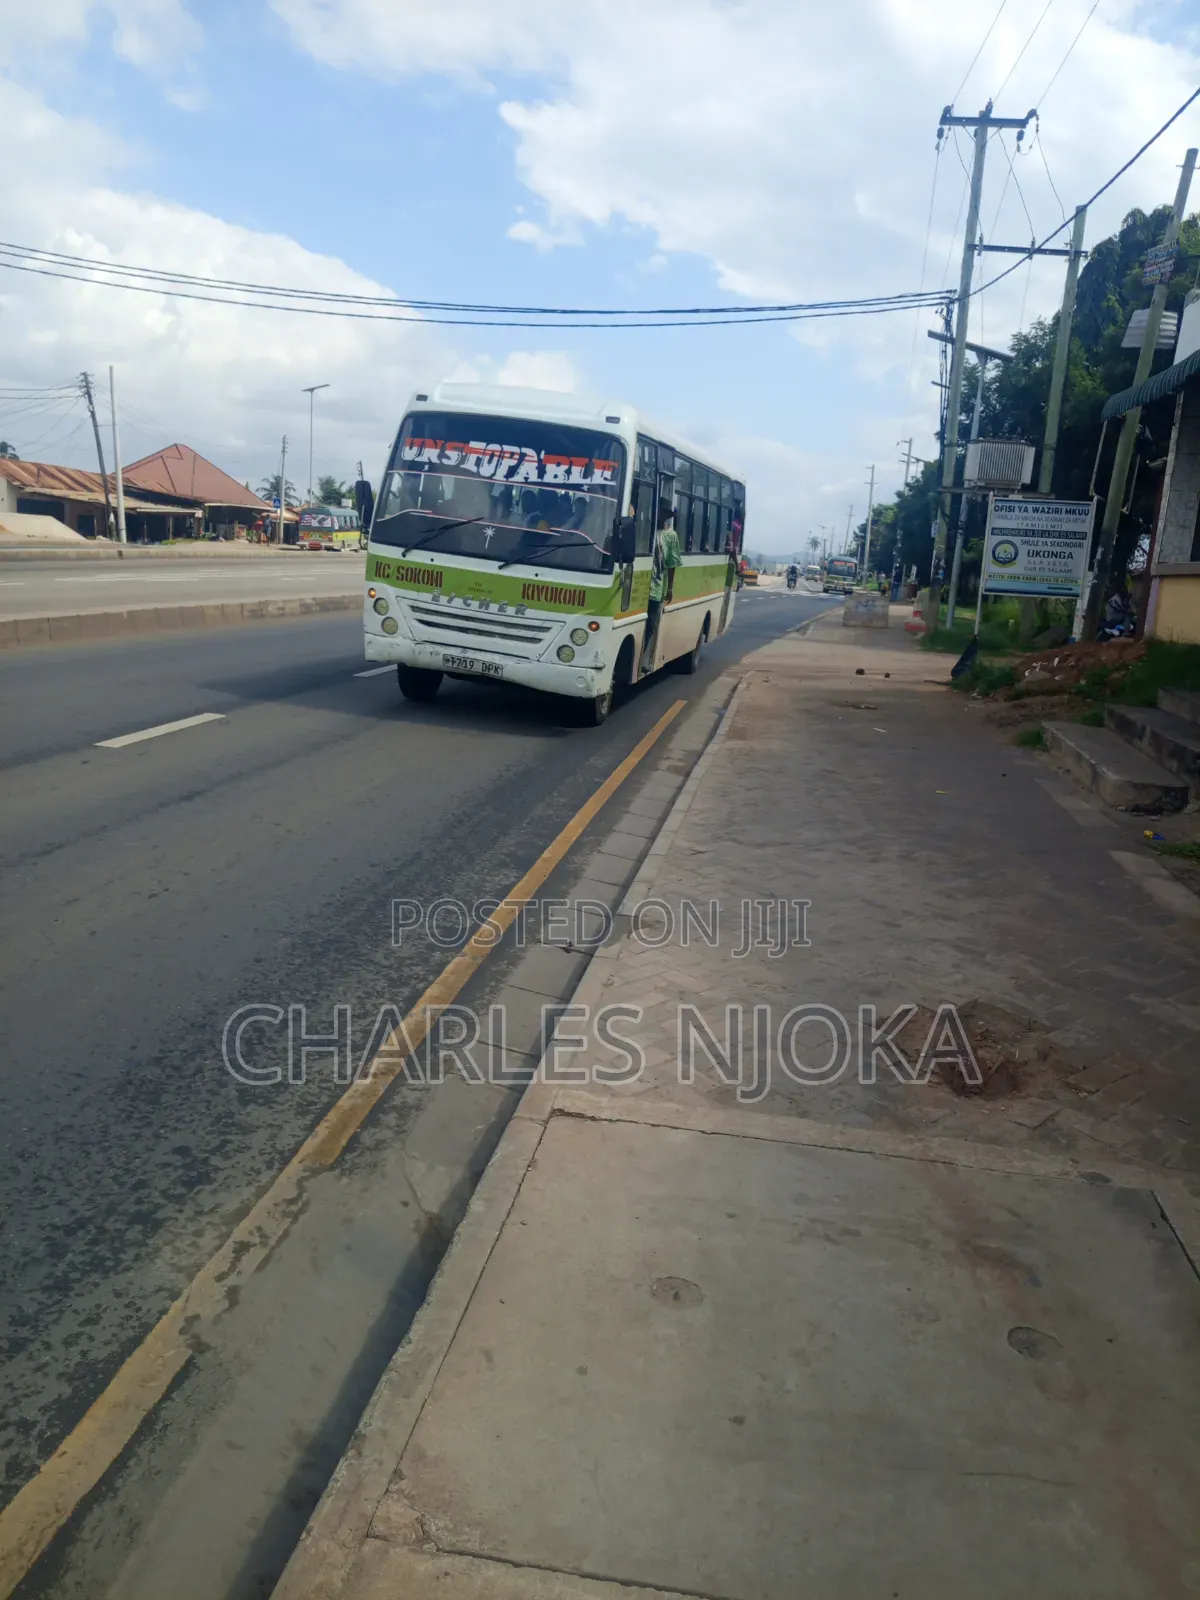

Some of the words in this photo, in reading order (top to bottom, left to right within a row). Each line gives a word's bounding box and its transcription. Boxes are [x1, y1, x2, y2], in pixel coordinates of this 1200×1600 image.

[401, 437, 619, 486] UNSTOPABLE
[993, 504, 1016, 513] OFISI
[1017, 505, 1029, 514] YA
[1031, 506, 1063, 515] WAZIRI
[1065, 507, 1090, 517] MKUU
[1020, 539, 1040, 547] SHULE
[1050, 540, 1084, 549] SEKONDARI
[1027, 549, 1074, 560] UKONGA
[430, 590, 529, 616] EICHER
[481, 662, 500, 676] DPK
